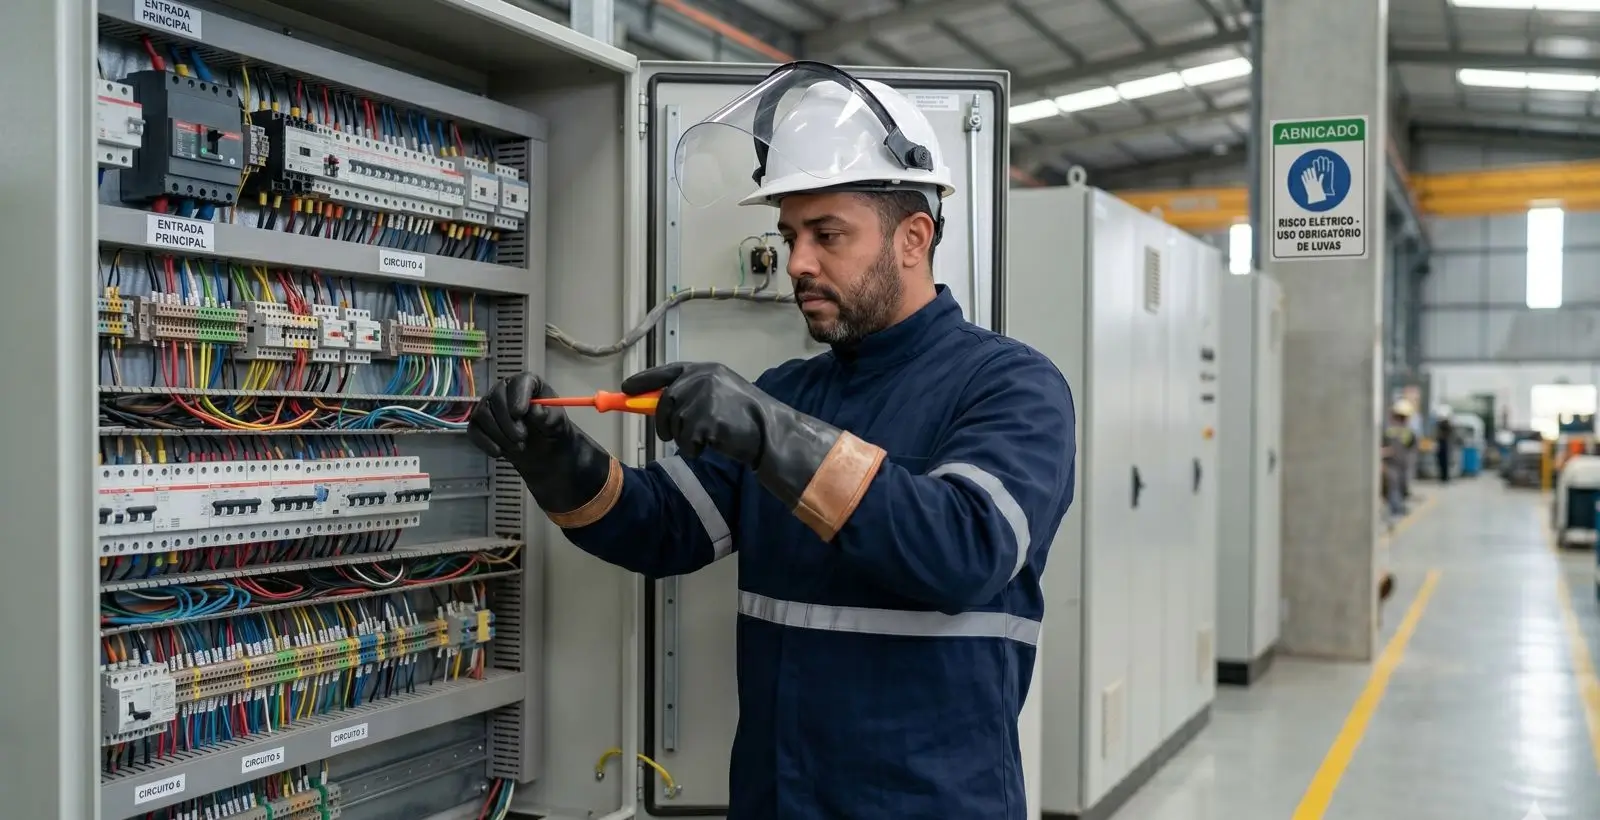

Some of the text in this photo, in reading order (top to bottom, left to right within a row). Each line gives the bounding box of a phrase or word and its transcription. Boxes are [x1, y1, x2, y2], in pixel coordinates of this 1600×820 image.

[145, 0, 190, 20] ENTRADA
[143, 10, 193, 33] PRINCIPAL
[1279, 124, 1359, 140] ABNICADO
[158, 219, 204, 235] ENTRADA
[1278, 218, 1306, 228] RISCO
[1309, 215, 1354, 227] ELÉTRICO
[155, 232, 206, 248] PRINCIPAL
[1277, 227, 1361, 240] USO OBRIGATÓRIO
[1297, 241, 1341, 251] DE LUVAS
[383, 257, 423, 270] CIRCUITO 4
[333, 727, 365, 742] CIRCUITO 3
[244, 752, 281, 768] CIRCUITO 5
[138, 780, 181, 798] CIRCUITO 6
